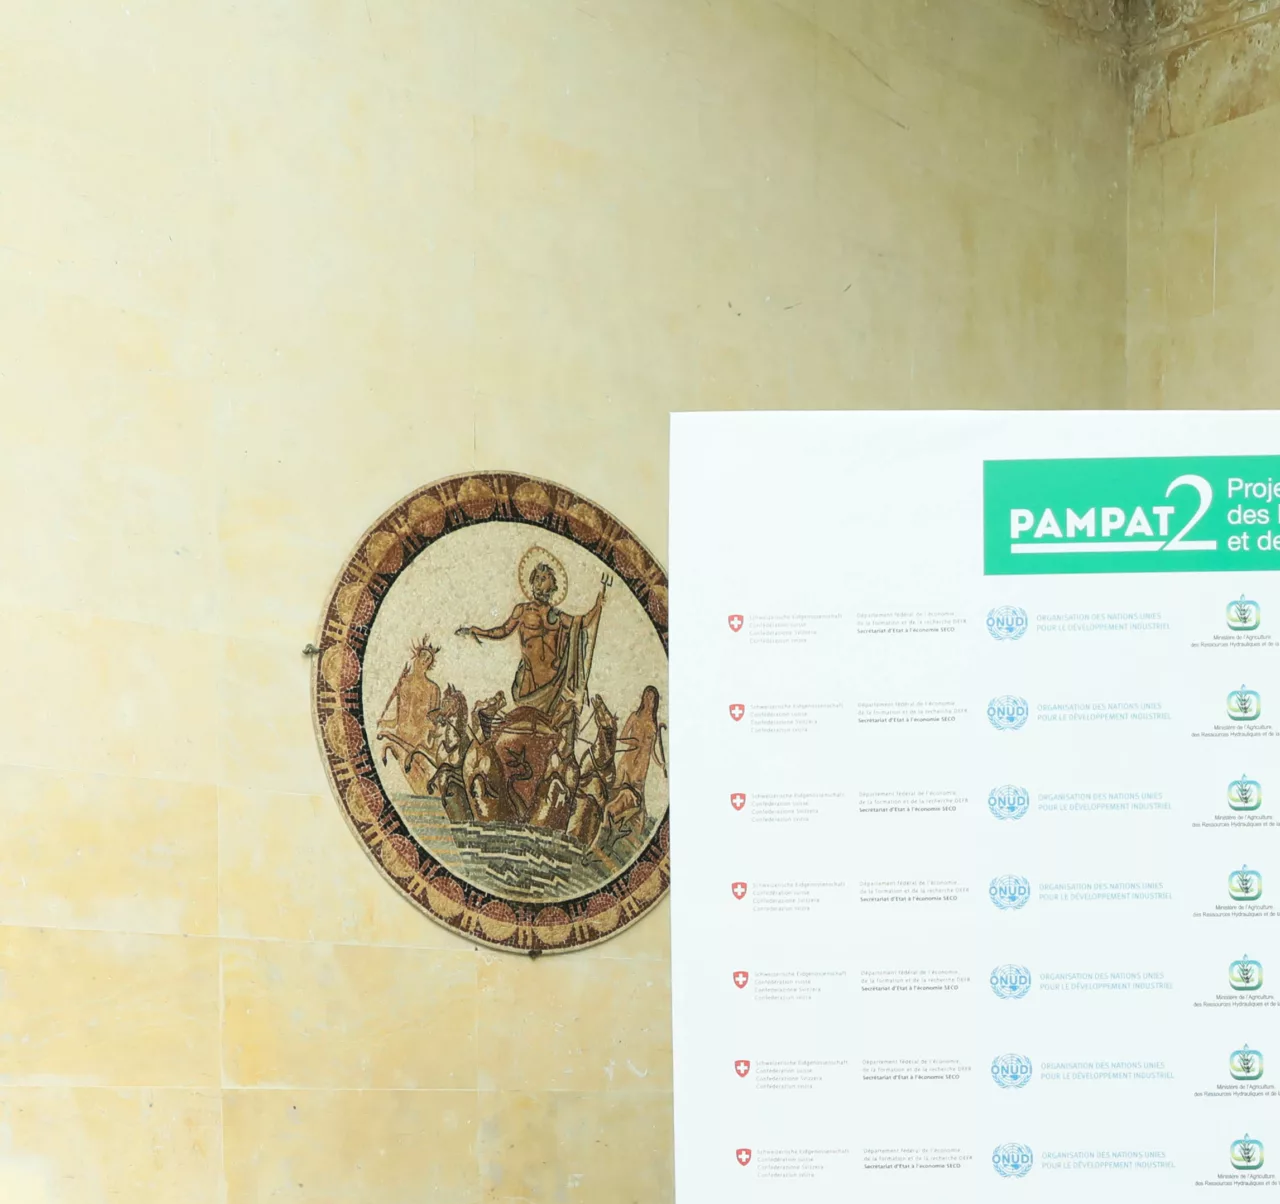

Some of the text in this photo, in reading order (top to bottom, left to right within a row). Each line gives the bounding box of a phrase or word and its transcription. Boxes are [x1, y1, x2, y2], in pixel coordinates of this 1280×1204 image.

[1010, 474, 1217, 551] PAMPAT2
[1227, 504, 1270, 525] des
[1227, 531, 1250, 551] et
[986, 616, 1028, 626] ONUDI
[986, 706, 1029, 716] ONUDI
[987, 795, 1030, 806] ONUDI
[988, 885, 1031, 895] ONUDI
[989, 974, 1032, 985] ONUDI
[990, 1064, 1032, 1074] ONUDI
[991, 1153, 1034, 1163] ONUDI
